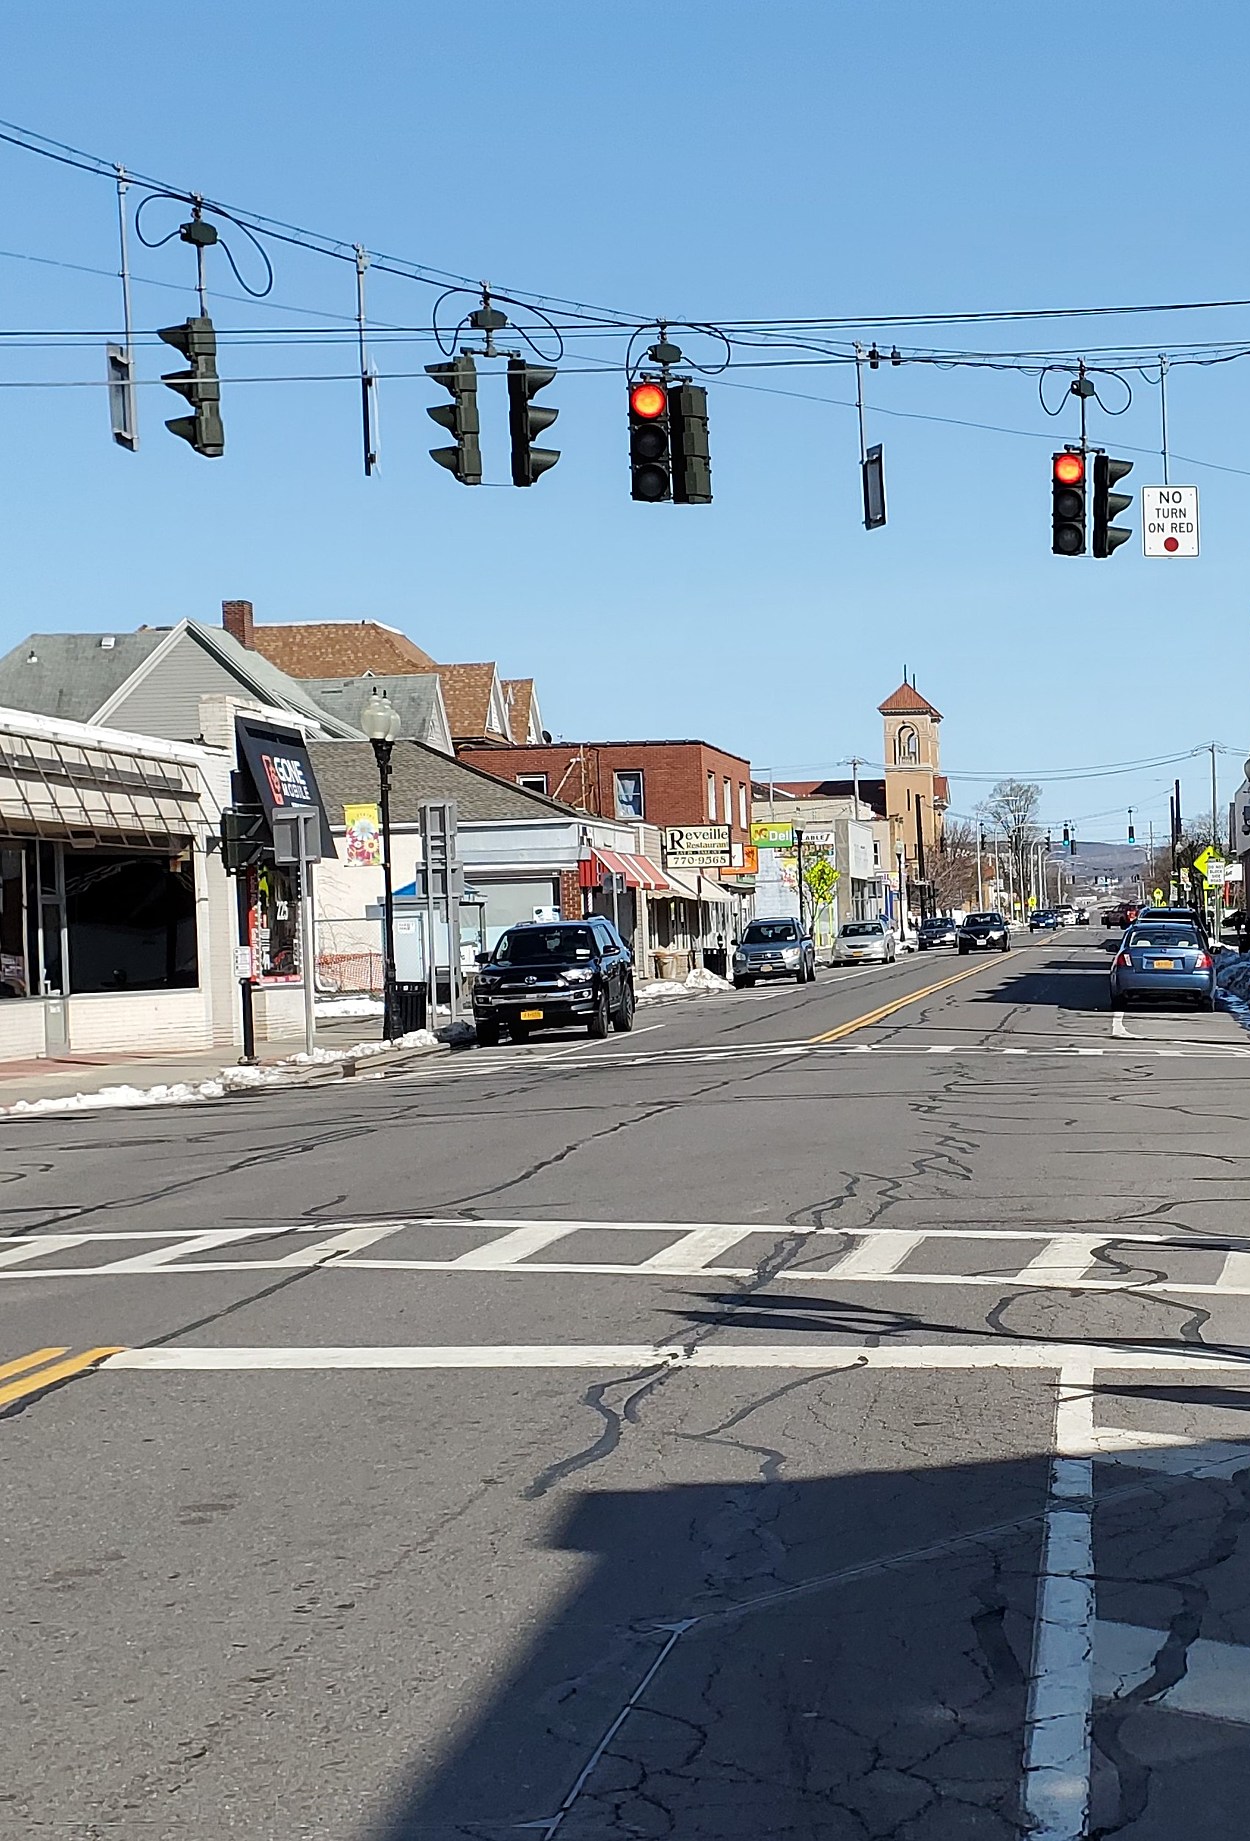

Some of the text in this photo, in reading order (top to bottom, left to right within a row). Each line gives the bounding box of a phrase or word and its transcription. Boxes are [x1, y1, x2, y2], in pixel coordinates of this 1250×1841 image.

[1159, 490, 1182, 504] NO
[1155, 507, 1187, 519] TURN
[1148, 522, 1193, 533] ON RED
[273, 757, 306, 785] GONE
[282, 783, 311, 800] MOBILE
[668, 828, 728, 850] Reveille
[673, 856, 727, 865] 770-9568
